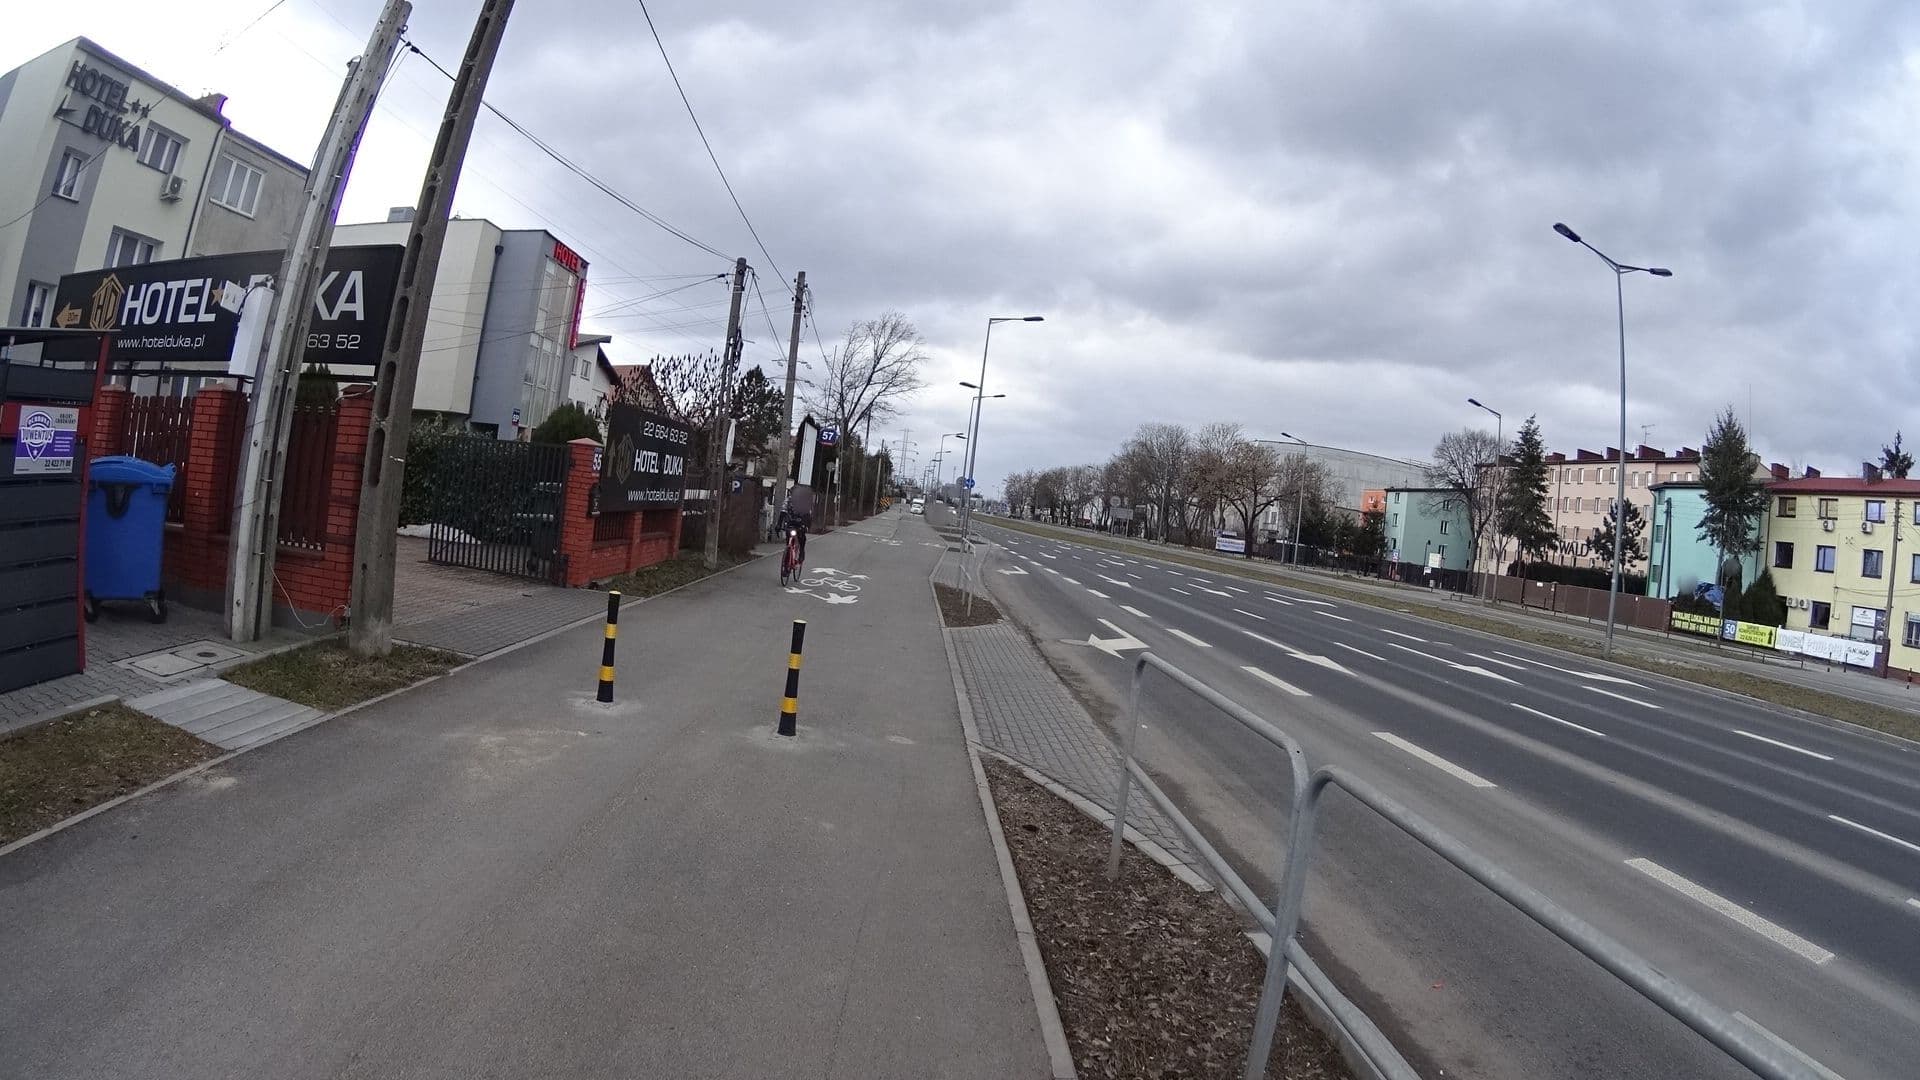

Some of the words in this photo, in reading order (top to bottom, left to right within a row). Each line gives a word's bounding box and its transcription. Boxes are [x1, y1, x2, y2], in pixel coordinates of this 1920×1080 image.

[65, 60, 129, 114] HOTEL
[82, 104, 140, 152] DUKA
[121, 278, 216, 326] HOTEL
[117, 334, 206, 349] www.hotelduka.pl
[307, 333, 330, 349] 63
[335, 334, 361, 349] 52
[643, 421, 655, 437] 22
[655, 424, 669, 440] 664
[669, 428, 679, 443] 63
[679, 431, 688, 445] 52
[822, 431, 834, 441] 57
[592, 453, 603, 471] 55
[633, 449, 660, 474] HOTEL
[663, 454, 684, 477] DUKA
[731, 480, 741, 491] P
[627, 488, 681, 503] www.hotelduka.pl
[1725, 623, 1736, 634] 50
